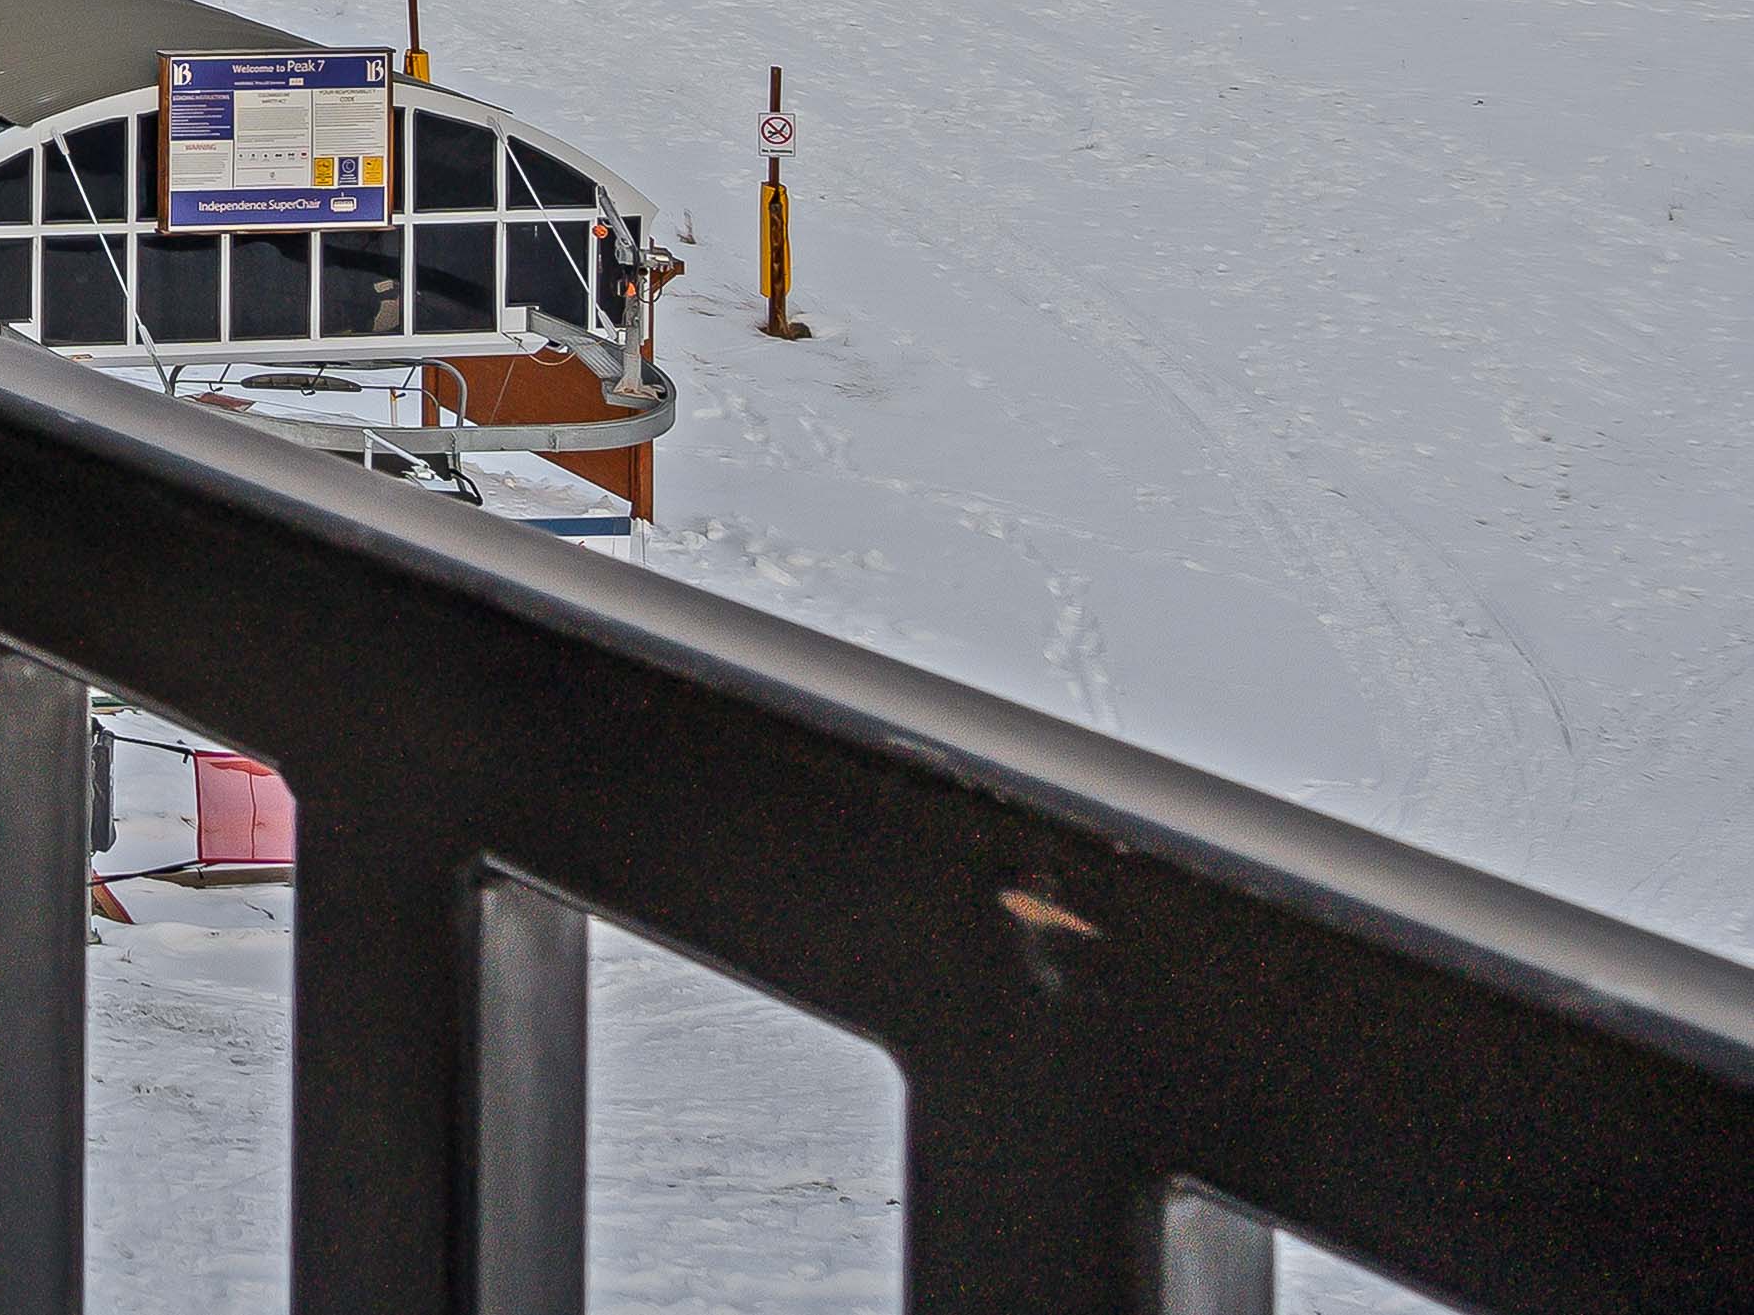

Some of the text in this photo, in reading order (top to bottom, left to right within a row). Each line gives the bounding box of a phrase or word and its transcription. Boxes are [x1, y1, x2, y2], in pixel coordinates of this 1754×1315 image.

[231, 59, 326, 74] Welcome to Peak 7
[198, 198, 321, 214] Independence SuperChair
